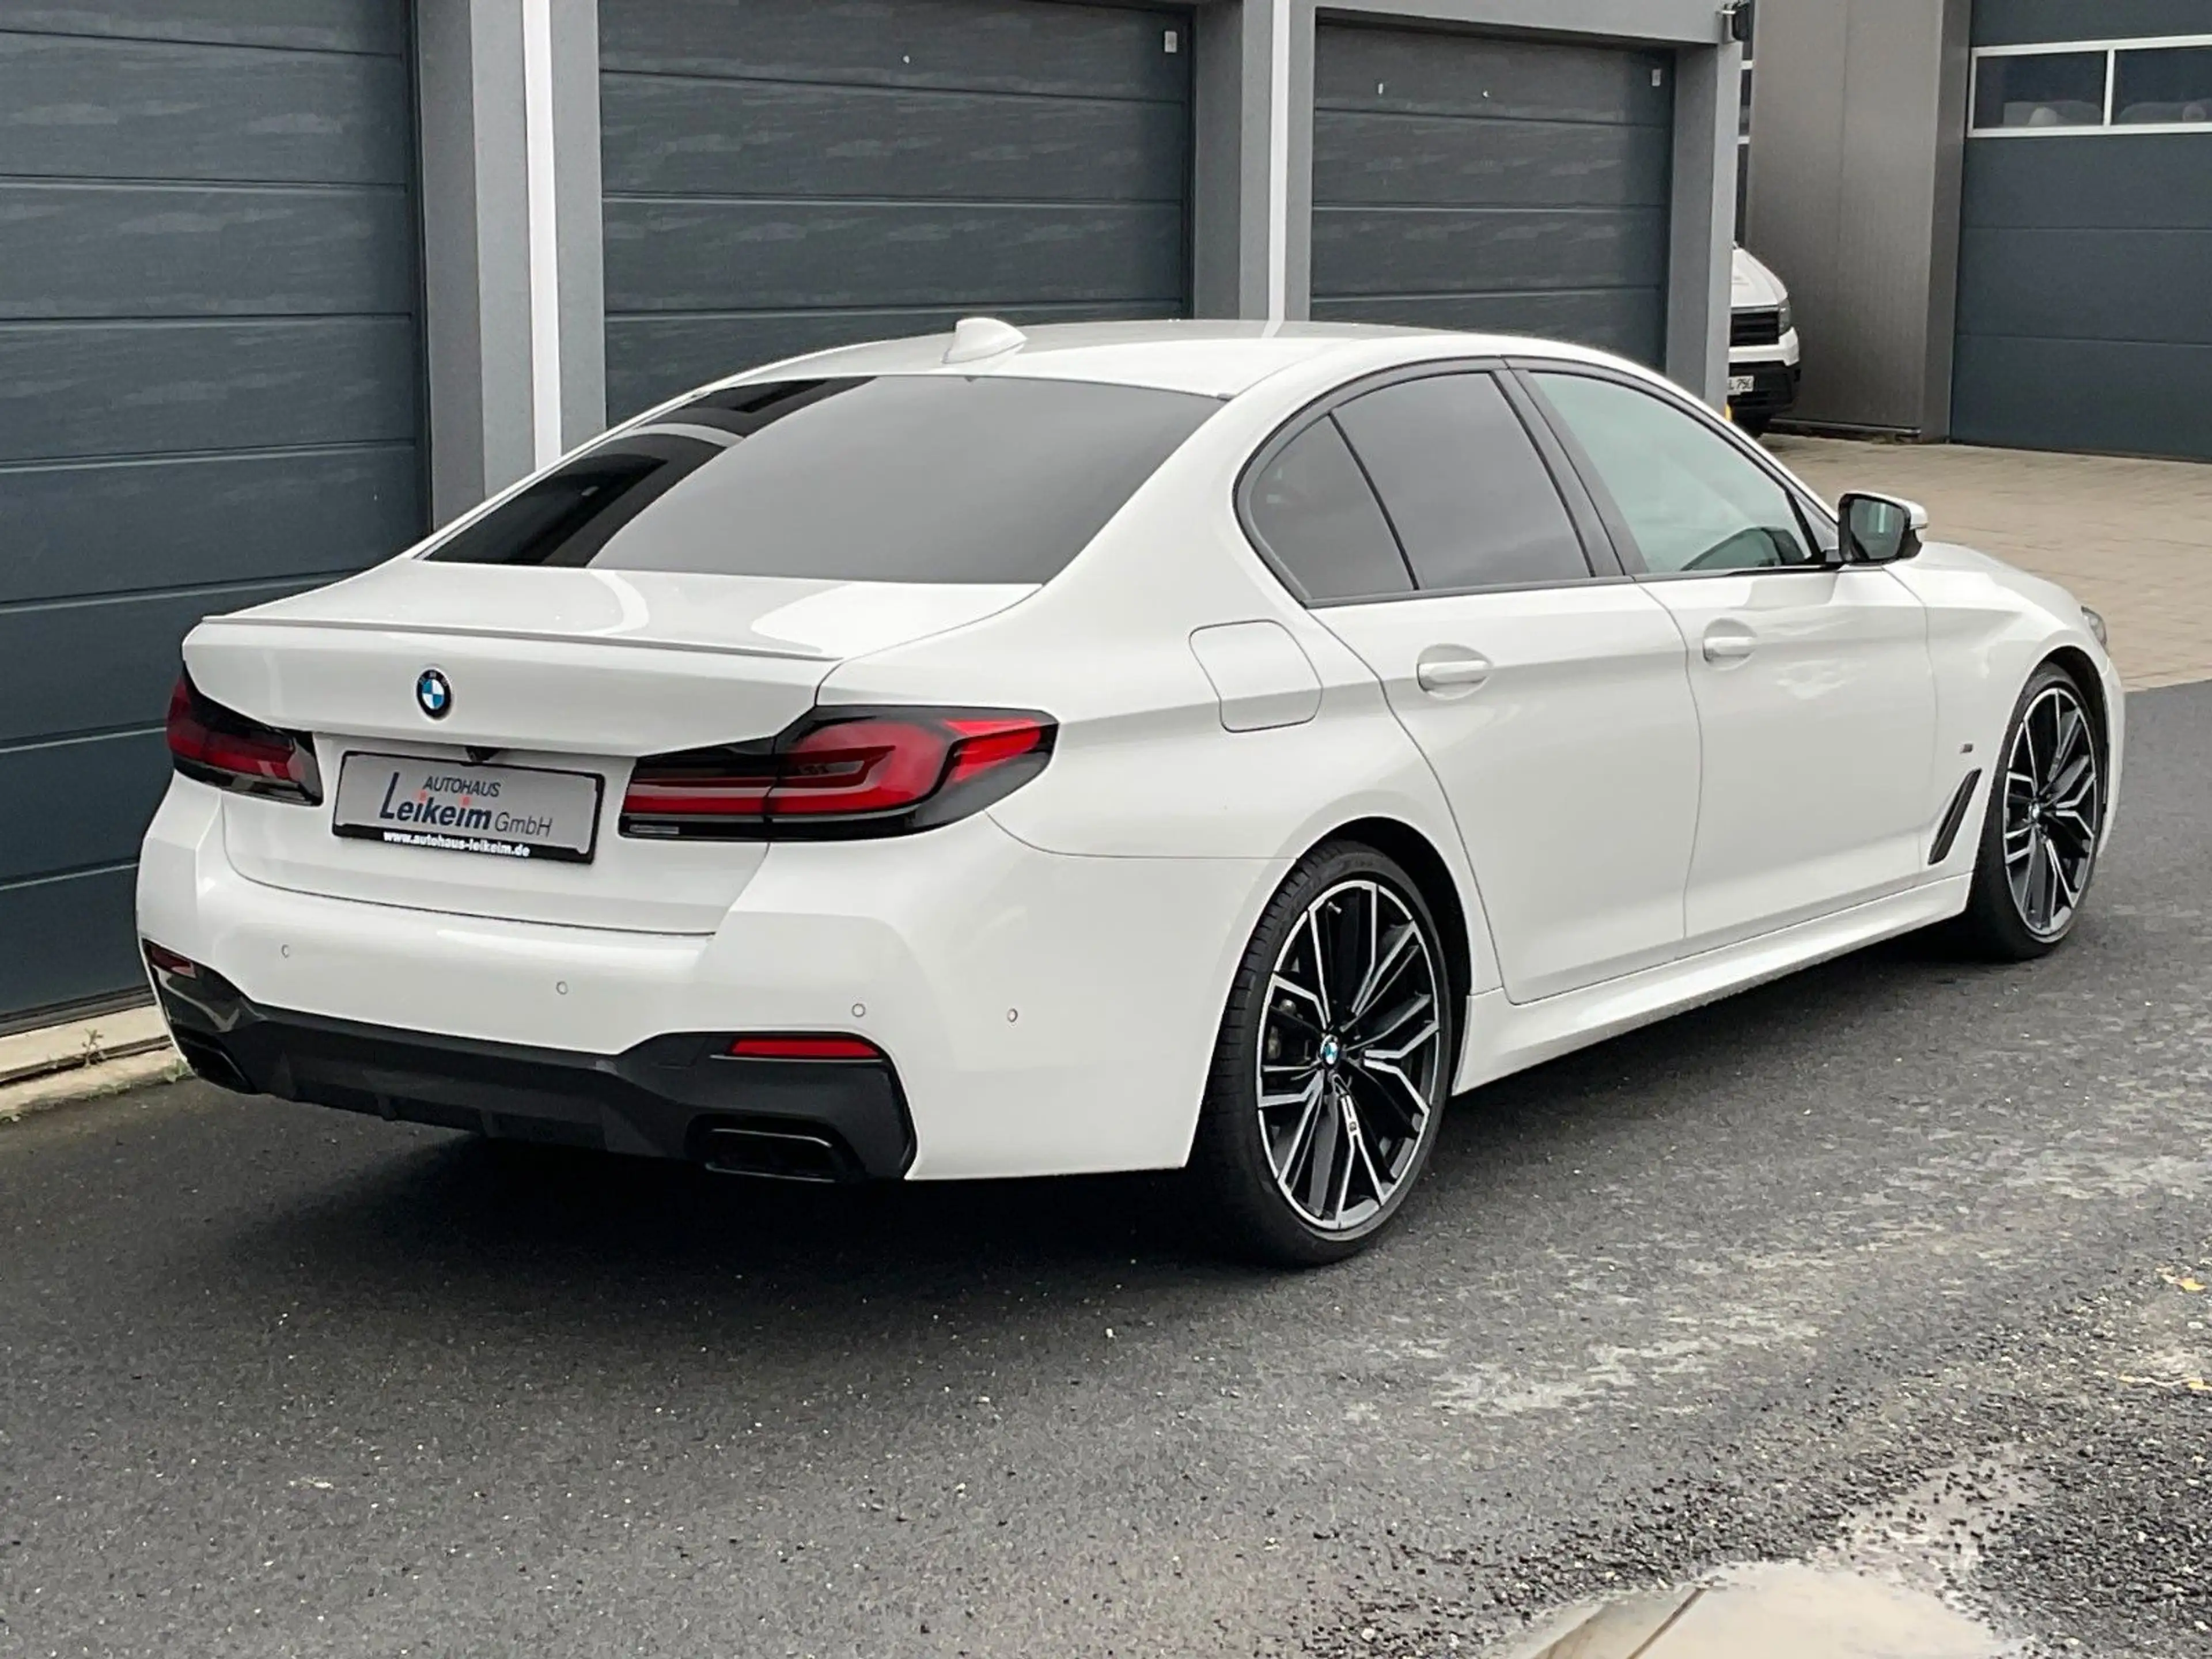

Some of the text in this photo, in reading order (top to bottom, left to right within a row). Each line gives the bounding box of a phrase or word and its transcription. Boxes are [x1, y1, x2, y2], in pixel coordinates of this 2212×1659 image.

[422, 775, 501, 797] AUTOHAUS
[379, 772, 553, 837] Leikeim GmbH
[383, 831, 530, 857] www.autohaus-leikeim.de
